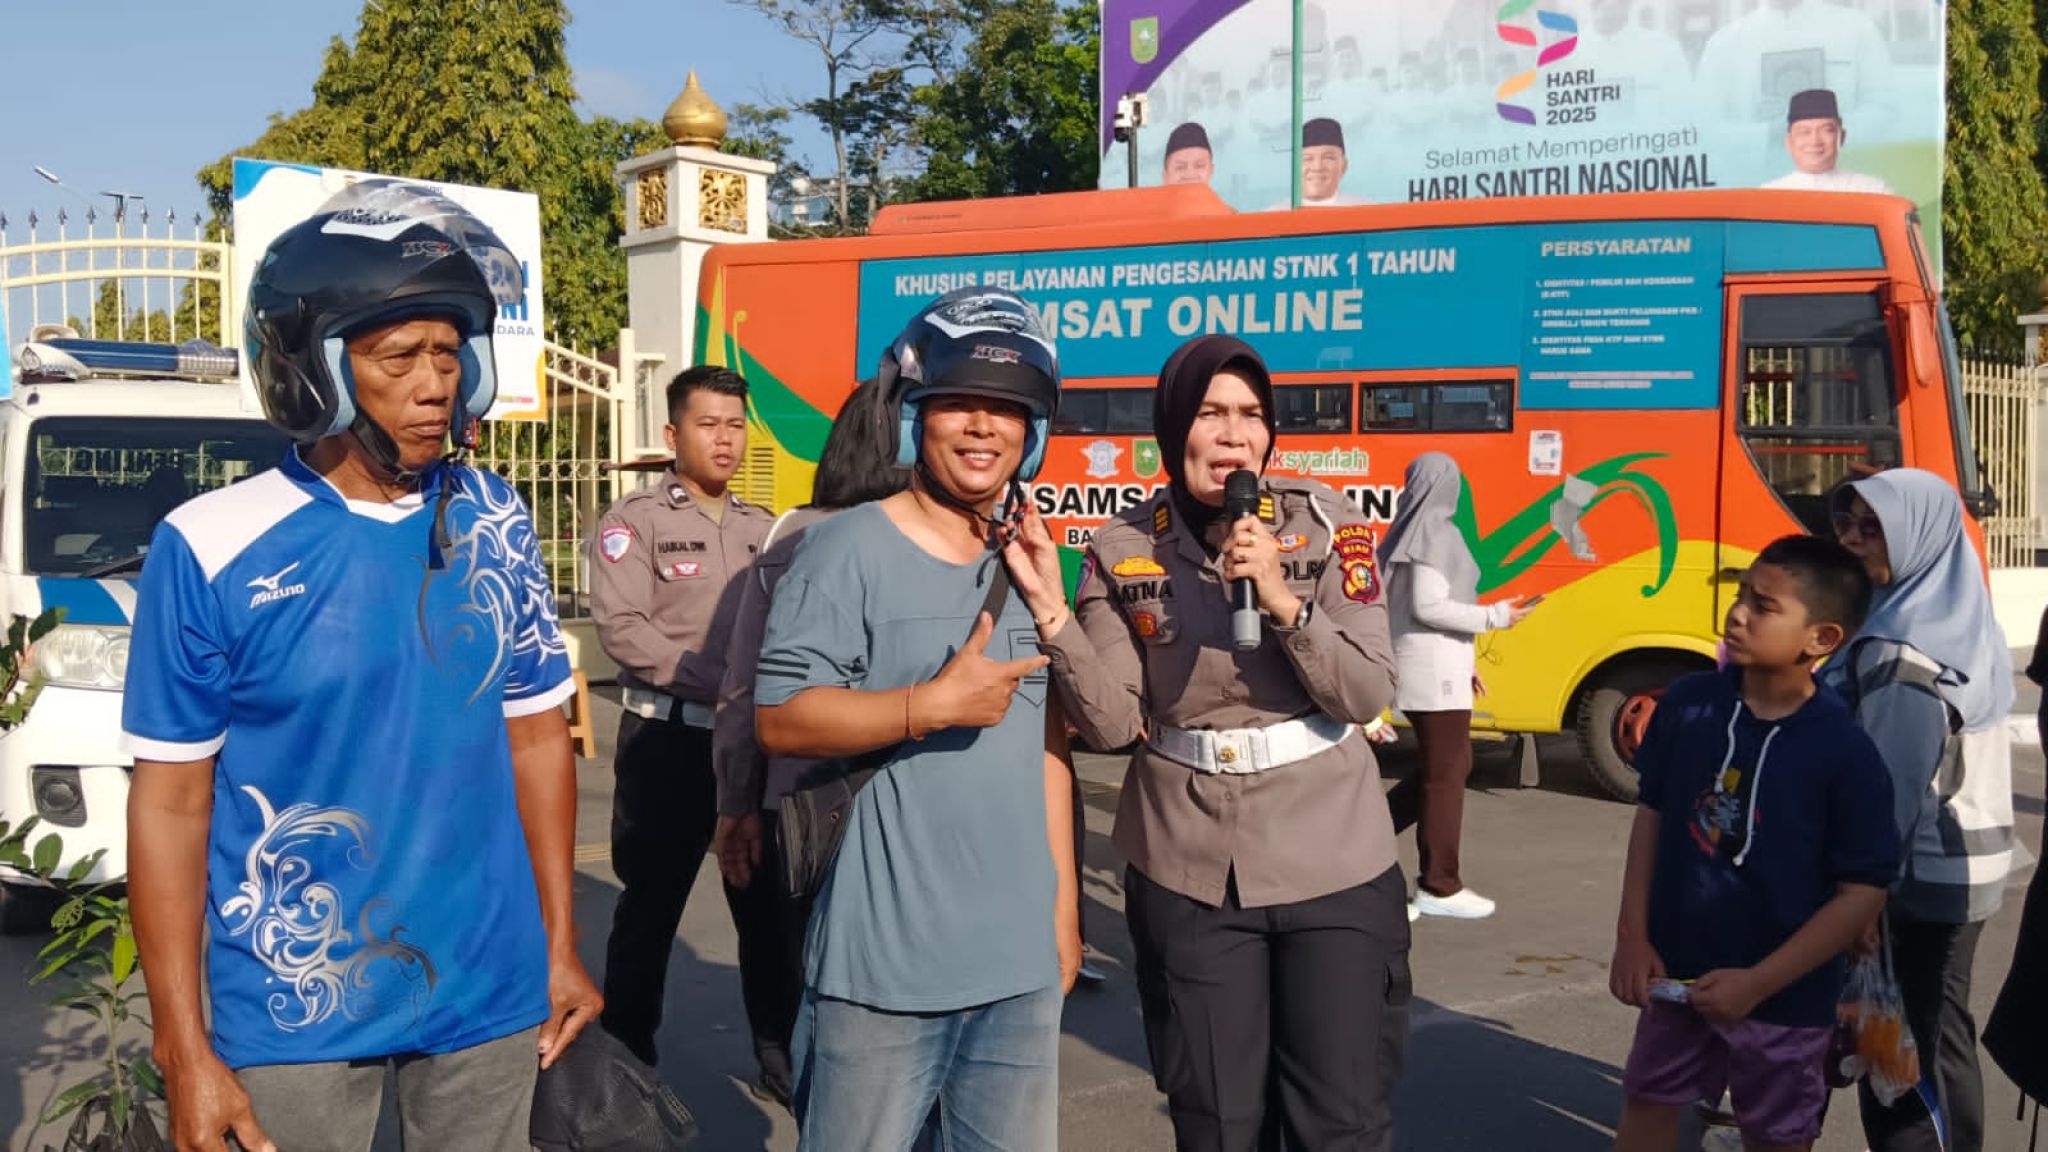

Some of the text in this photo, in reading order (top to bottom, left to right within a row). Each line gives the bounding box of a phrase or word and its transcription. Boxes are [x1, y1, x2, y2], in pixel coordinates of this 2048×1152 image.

[1546, 69, 1595, 88] HARI
[1546, 85, 1620, 108] SANTRI
[1545, 106, 1596, 126] 2025
[1425, 126, 1699, 170] Selamat Memperingati
[1408, 153, 1717, 201] HARI SANTRI NASIONAL
[1541, 237, 1692, 257] PERSYARATAN
[895, 247, 1457, 296] KHUSUS PELAYANAN PENGESAHAN STNK 1 TAHUN
[1028, 289, 1363, 341] MSAT ONLINE
[493, 325, 535, 337] DARA
[1270, 449, 1368, 473] ksyariah
[1034, 485, 1167, 515] SAMS
[1334, 526, 1371, 543] POLDA
